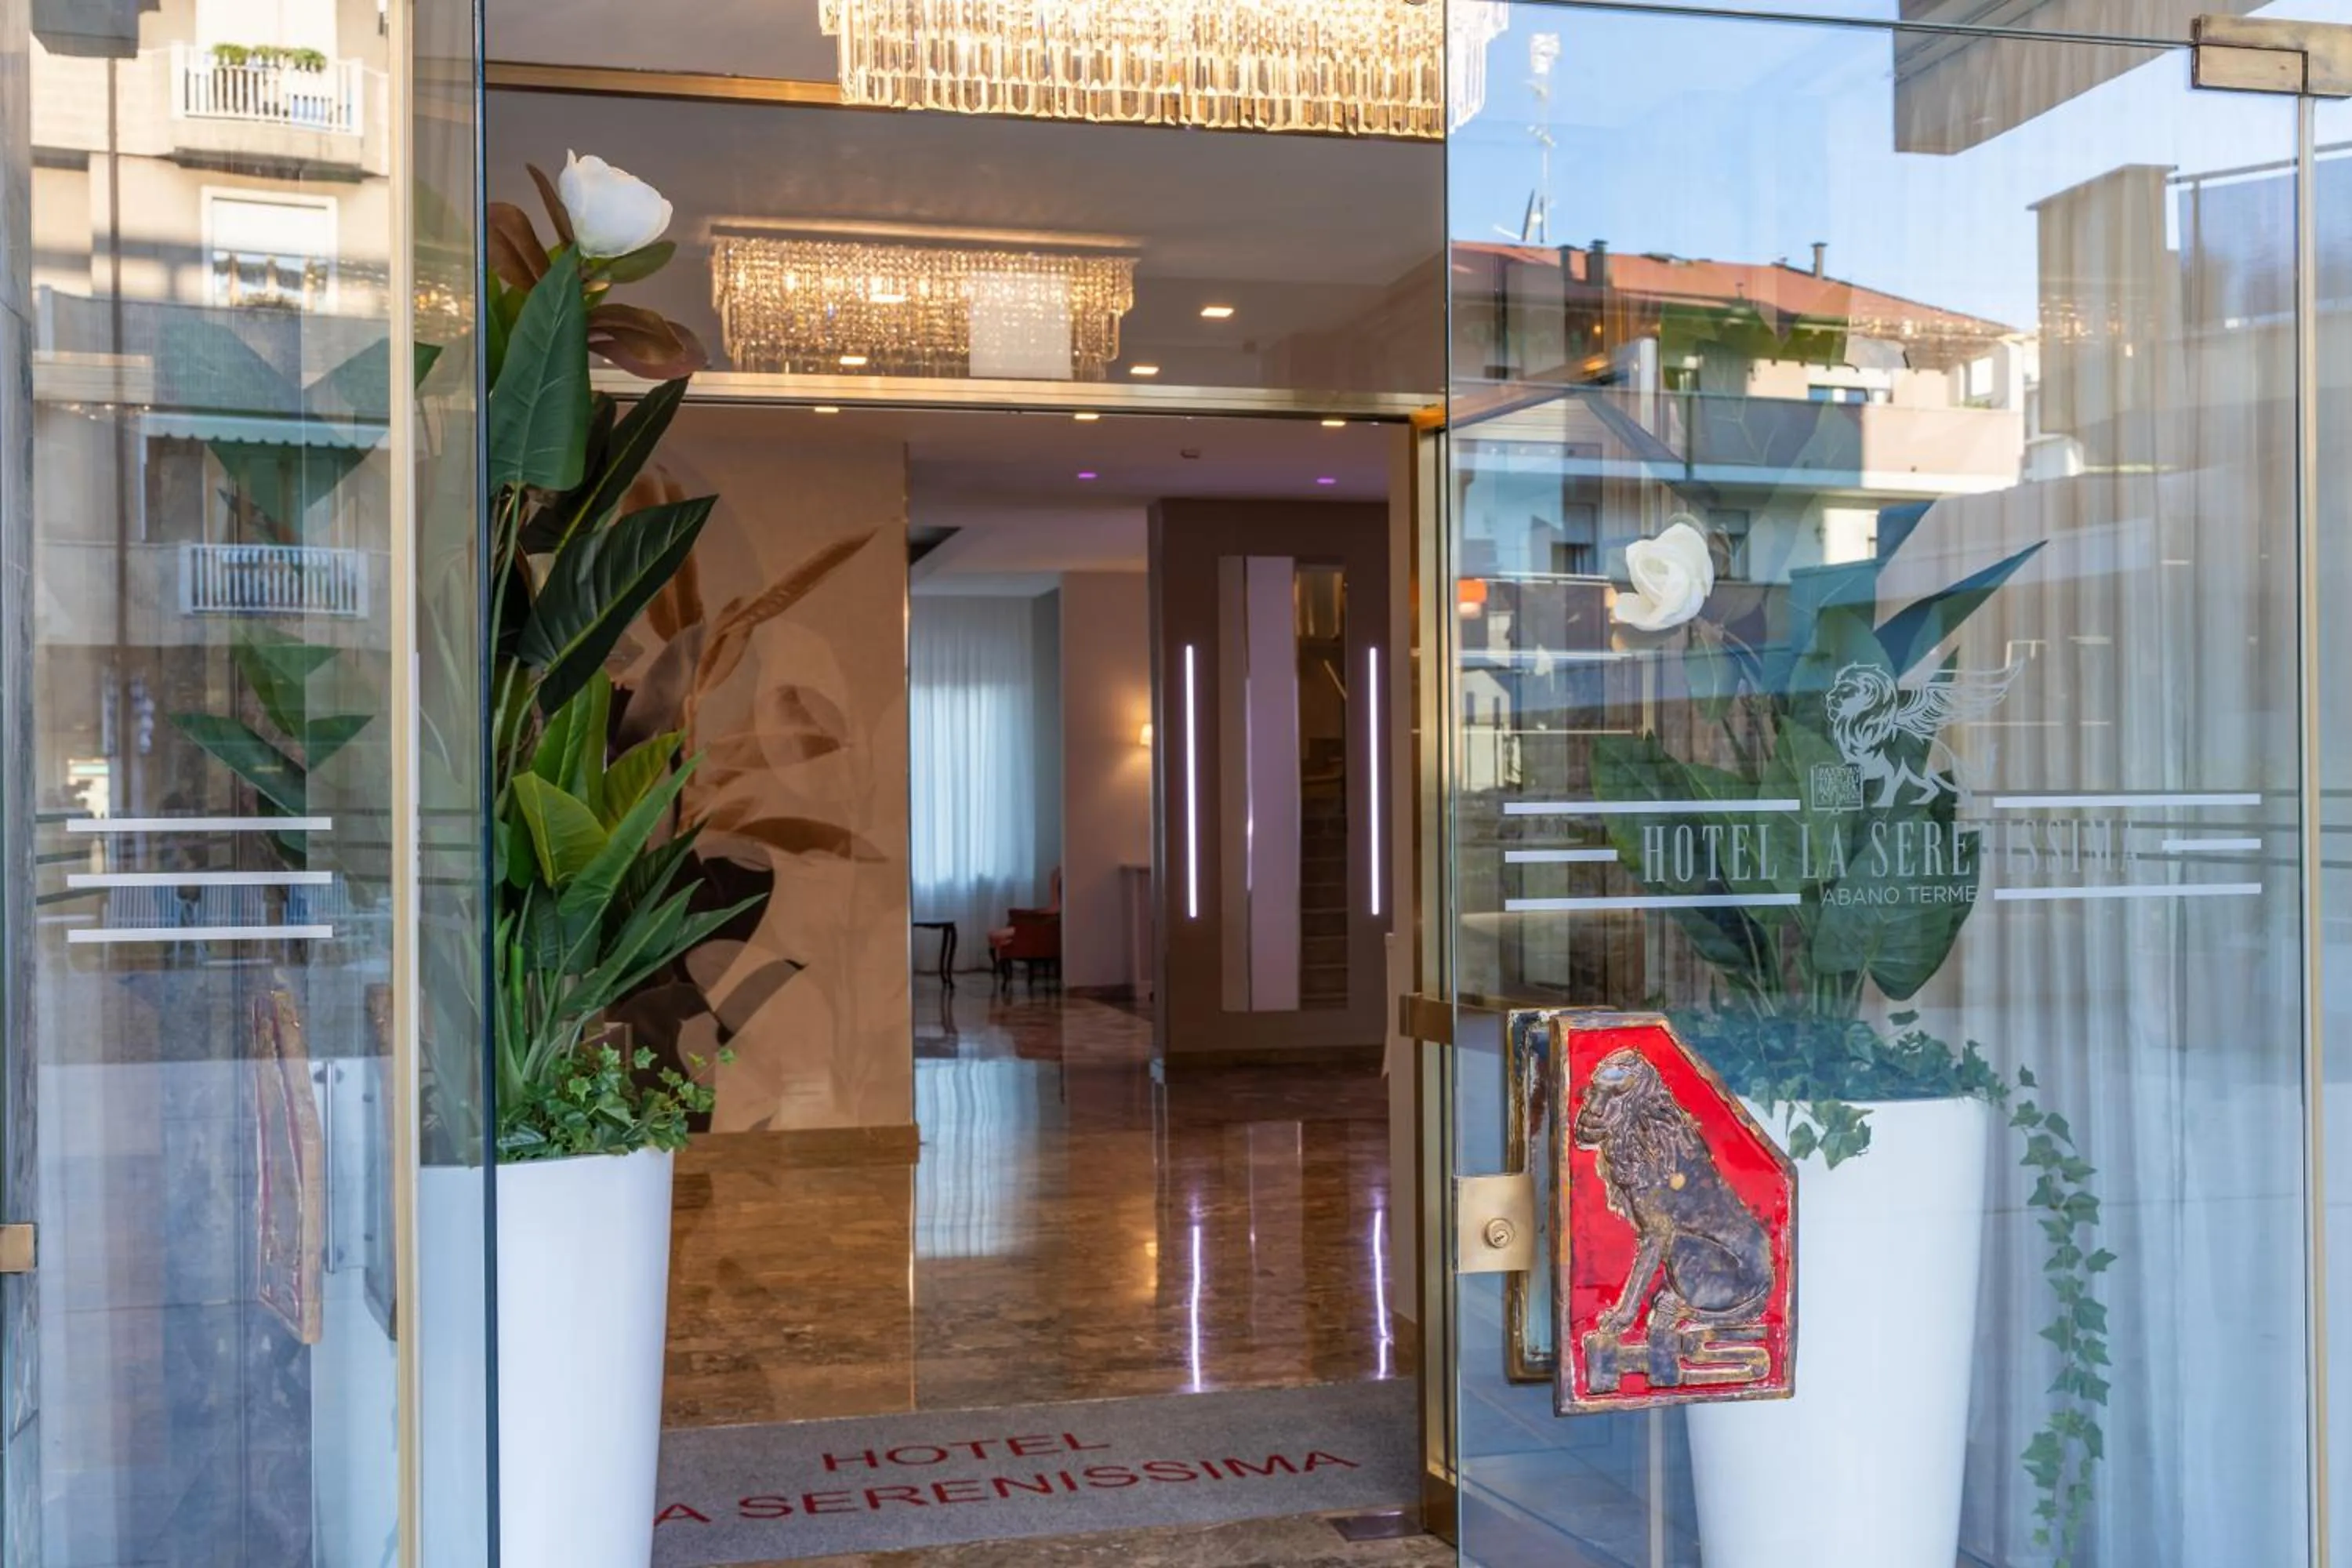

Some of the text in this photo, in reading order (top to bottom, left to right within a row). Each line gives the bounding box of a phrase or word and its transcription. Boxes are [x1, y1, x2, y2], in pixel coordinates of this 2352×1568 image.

[1643, 823, 1778, 883] HOTEL
[1802, 820, 1848, 879] LA
[1820, 884, 1979, 907] ABANO TERME
[821, 1432, 1112, 1472] HOTEL
[653, 1449, 1360, 1527] A SERENISSIMA
